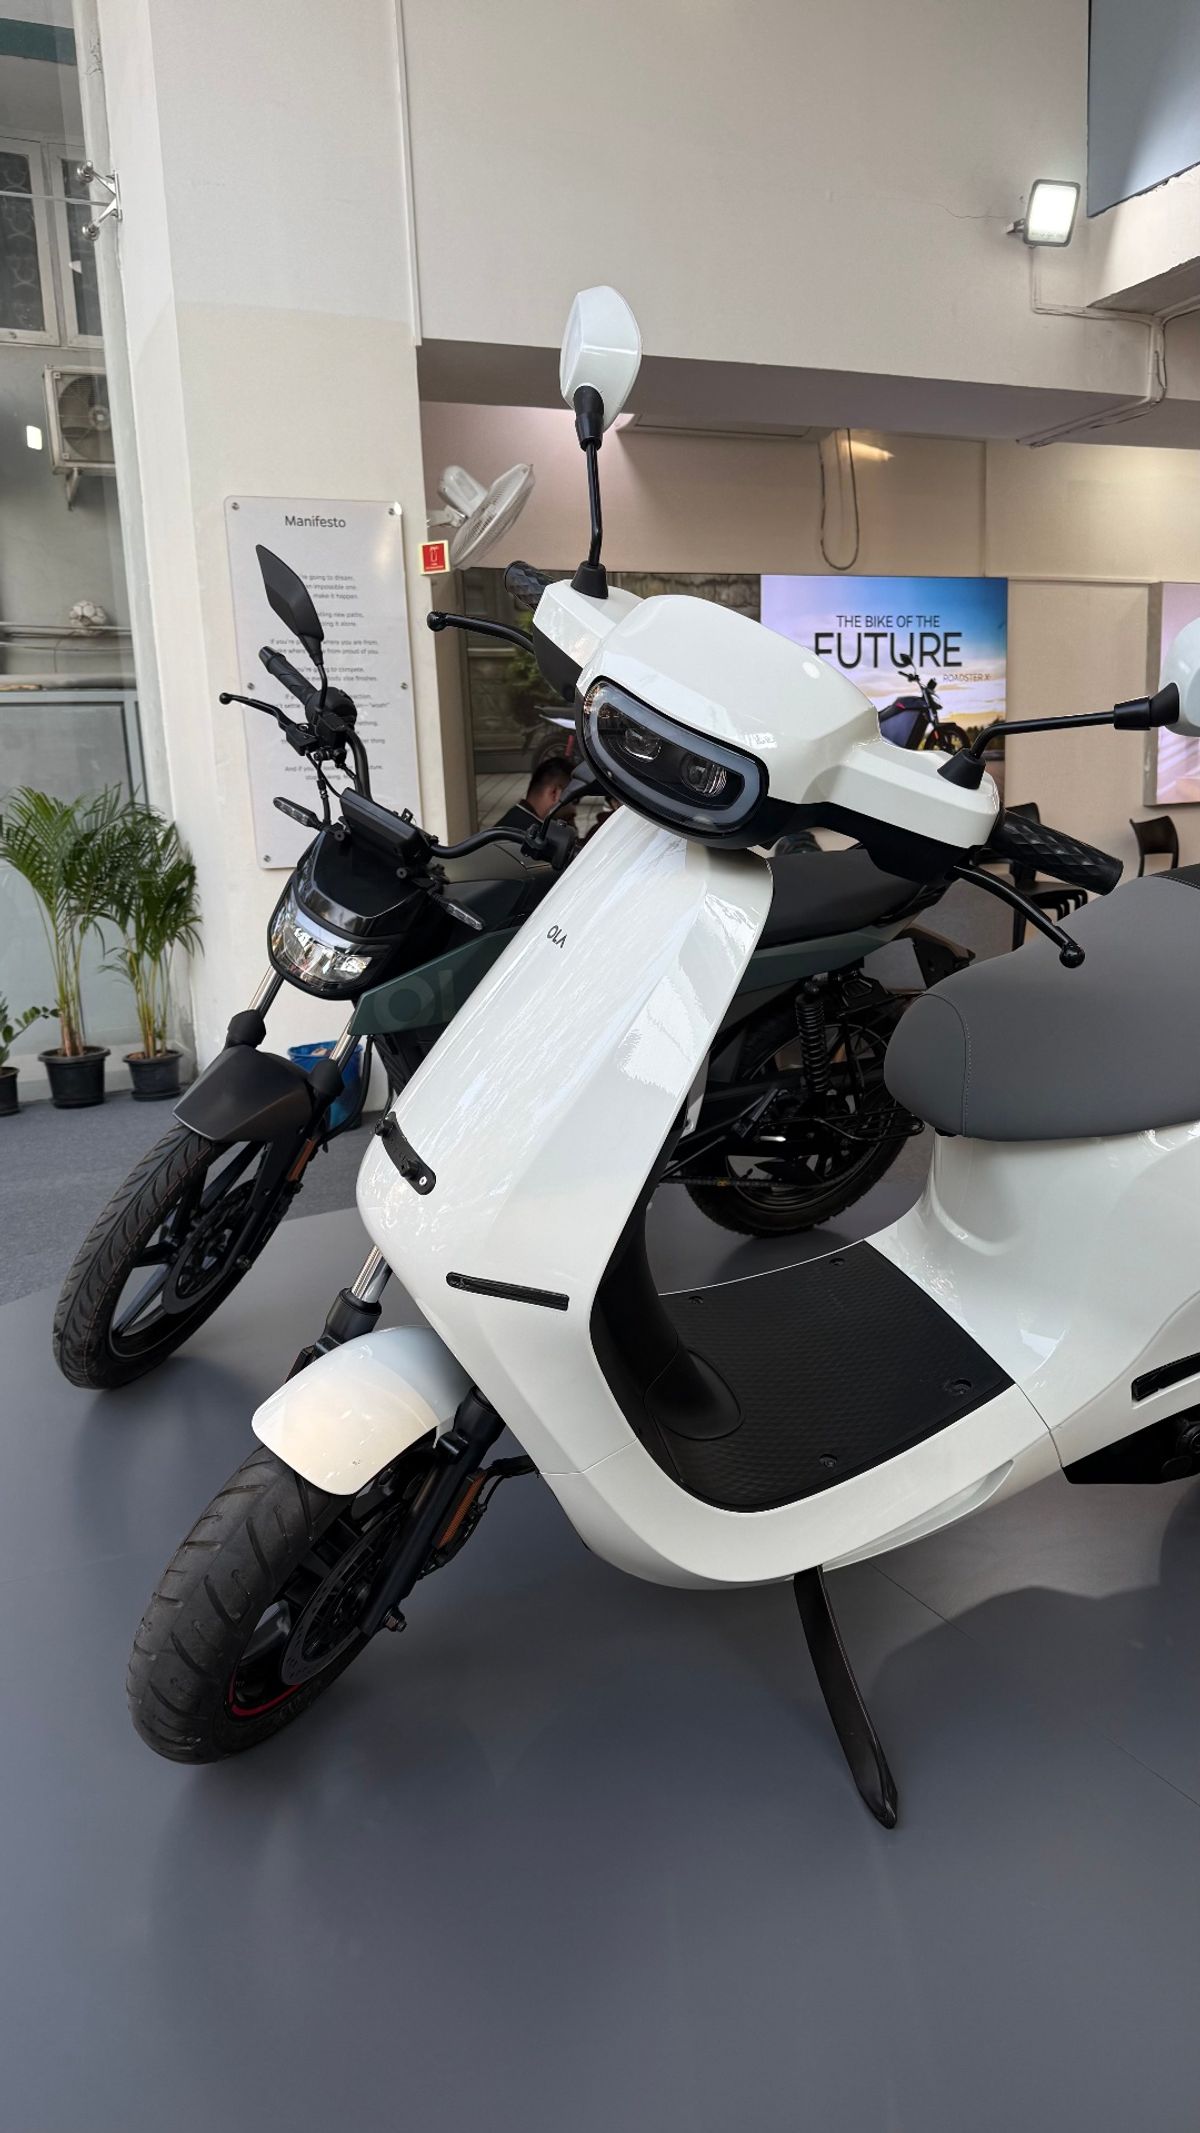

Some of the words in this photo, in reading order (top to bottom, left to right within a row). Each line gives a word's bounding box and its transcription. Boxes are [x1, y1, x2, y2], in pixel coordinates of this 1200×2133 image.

[285, 515, 346, 528] Manifesto
[836, 615, 862, 629] THE
[865, 615, 893, 629] BIKE
[896, 615, 914, 629] OF
[916, 615, 941, 629] THE
[814, 632, 963, 669] FUTURE
[546, 924, 568, 949] OLA
